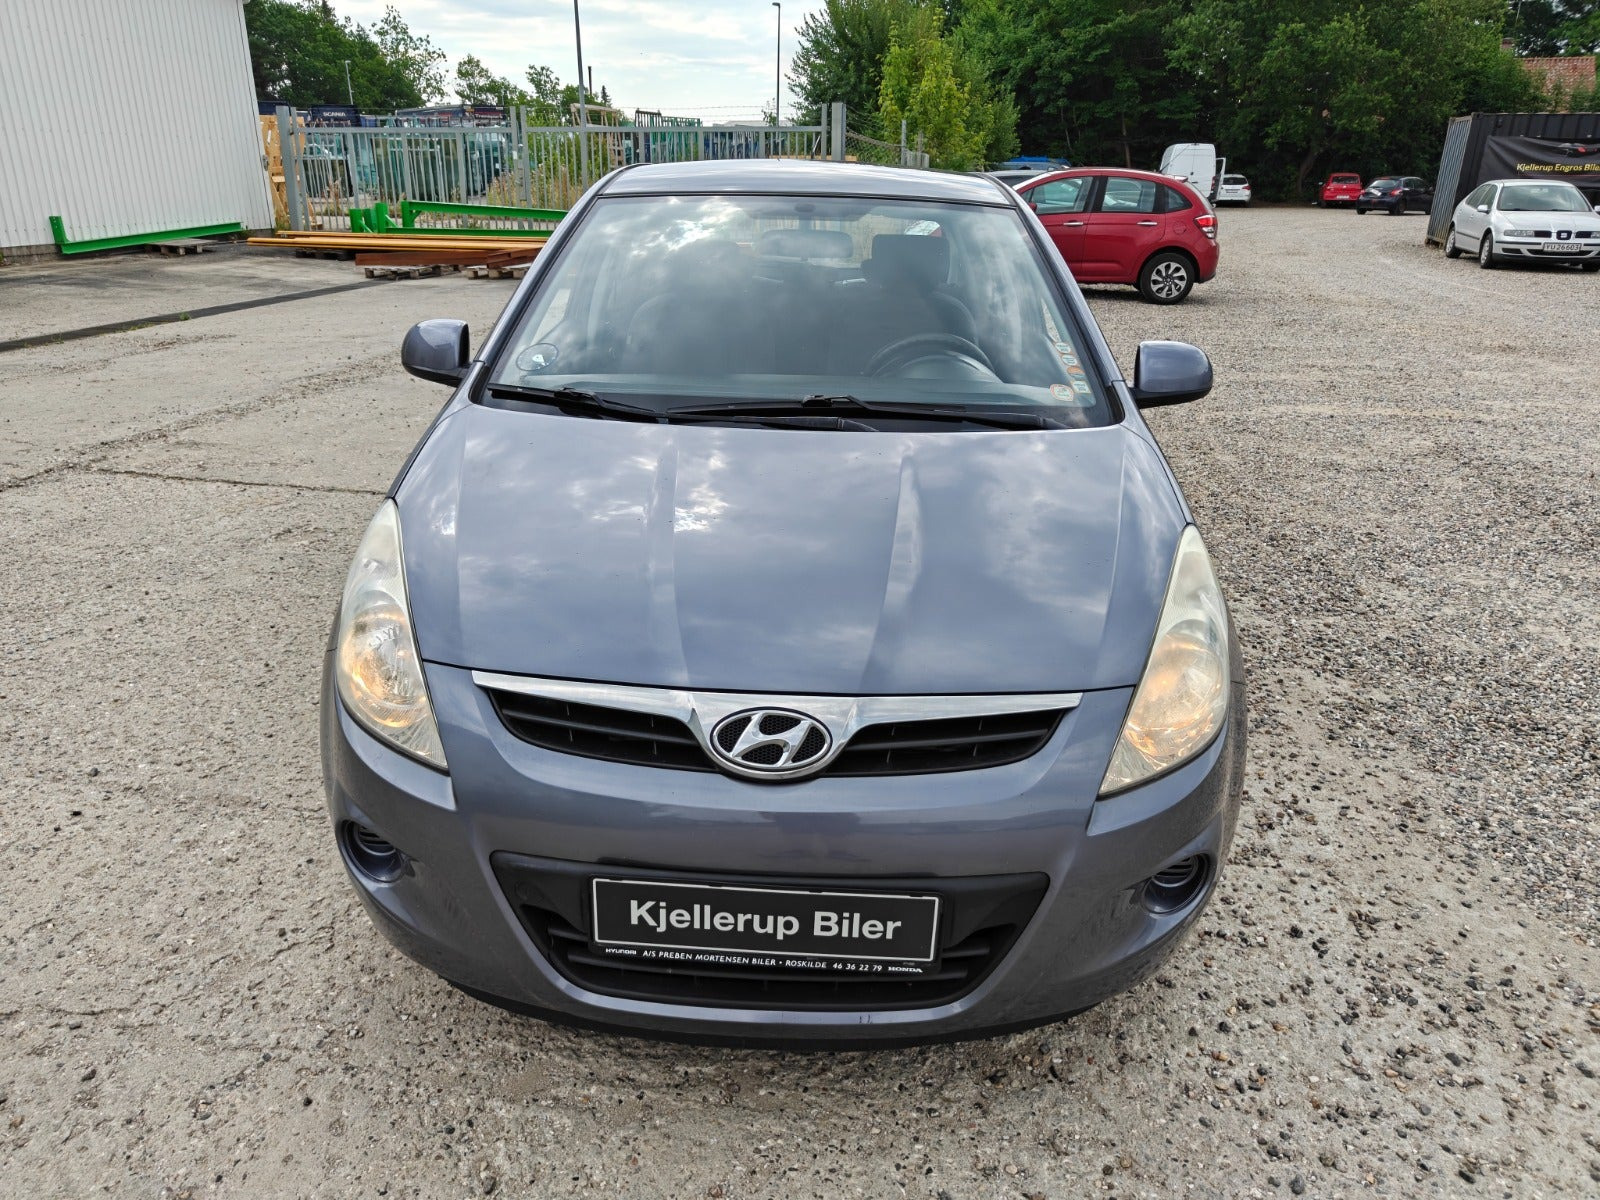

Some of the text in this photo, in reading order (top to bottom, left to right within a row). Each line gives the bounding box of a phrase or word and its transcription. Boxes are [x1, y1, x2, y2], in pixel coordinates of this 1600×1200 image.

[1516, 163, 1600, 173] Kjellerup Engros Bile
[630, 899, 902, 941] Kjellerup Biler
[605, 947, 637, 955] HYUNDAI
[642, 950, 656, 958] A/S
[658, 951, 693, 961] PREBEN
[694, 953, 750, 965] MORTENSEN
[751, 956, 776, 966] BILER
[785, 959, 827, 969] ROSKILDE
[872, 964, 883, 972] 79
